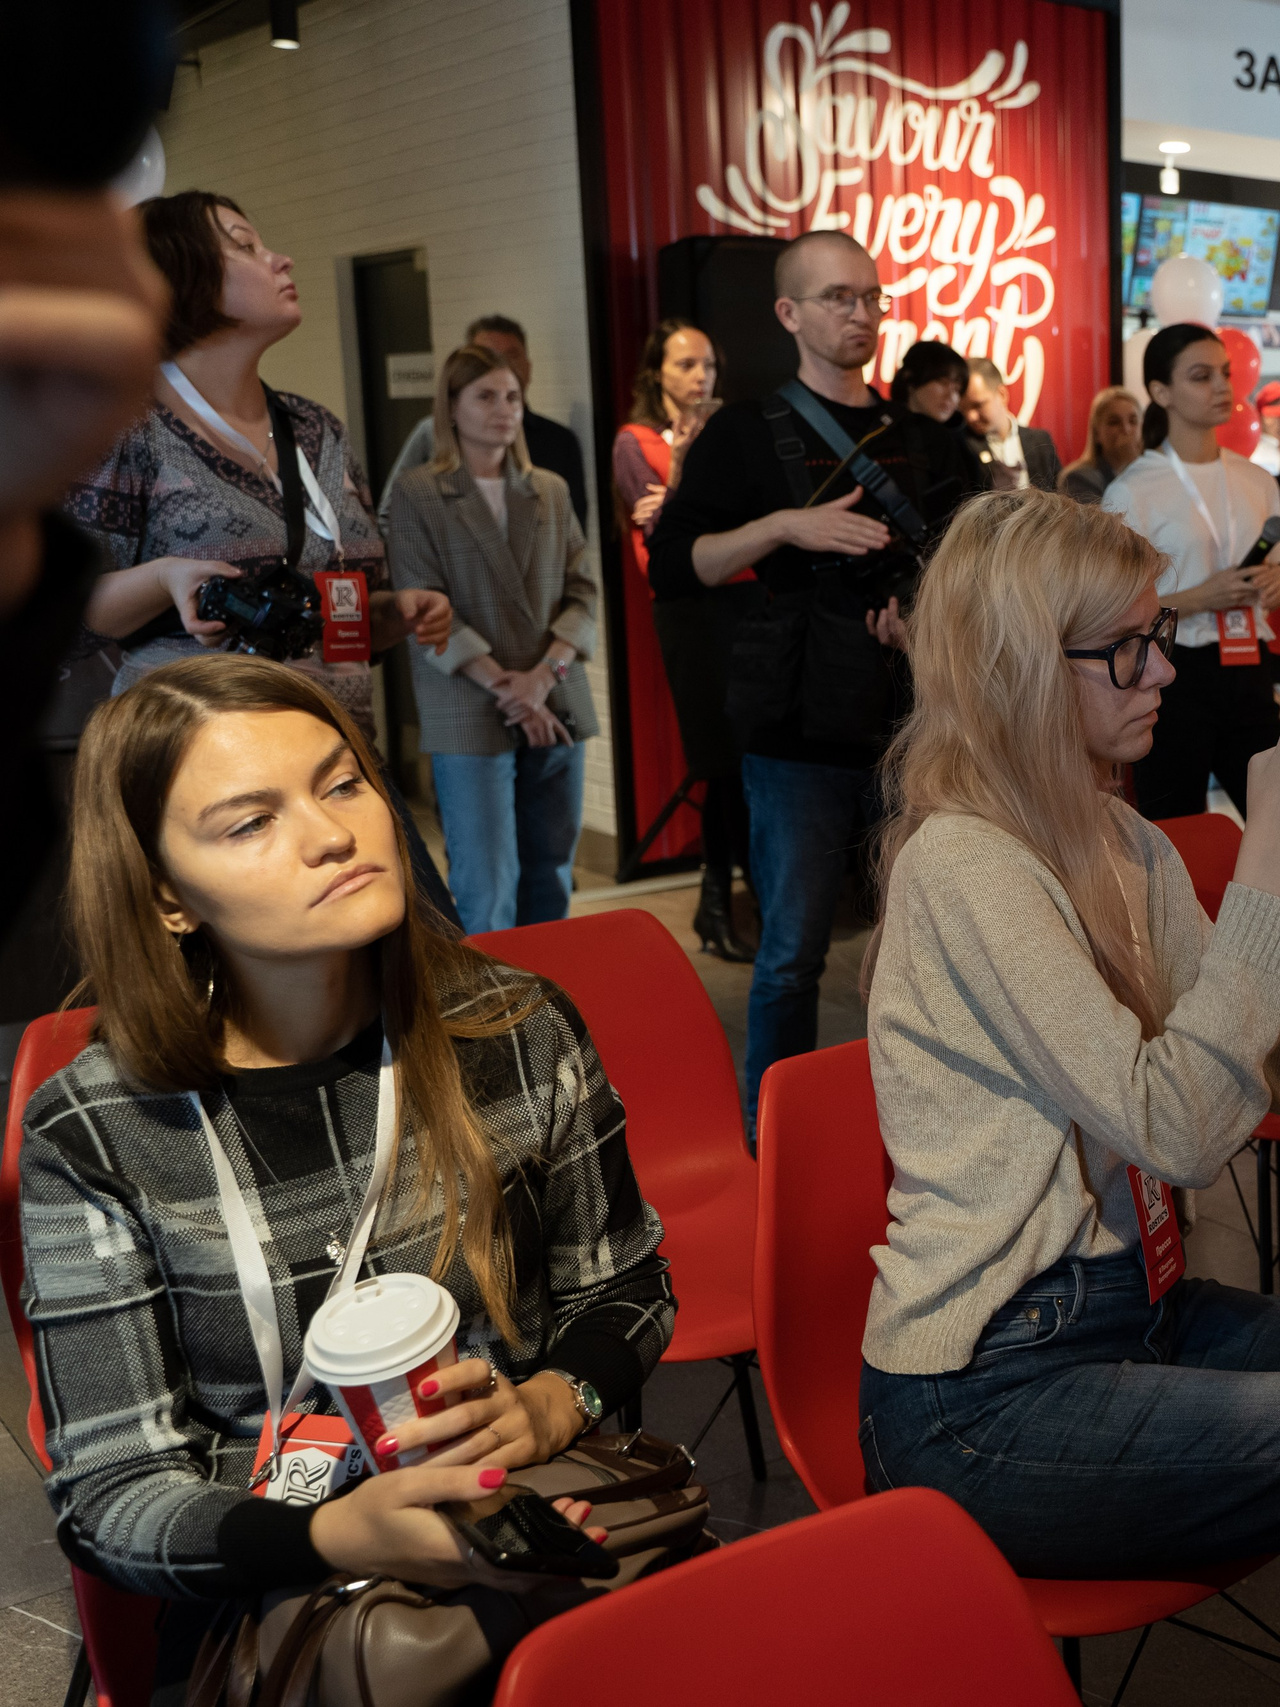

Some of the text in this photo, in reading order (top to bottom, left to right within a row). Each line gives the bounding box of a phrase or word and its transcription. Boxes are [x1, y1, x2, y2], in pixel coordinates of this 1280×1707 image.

[745, 21, 1005, 212] Savour
[812, 168, 1026, 317] Every
[336, 586, 355, 607] R
[1144, 1174, 1161, 1210] R
[282, 1457, 331, 1505] R
